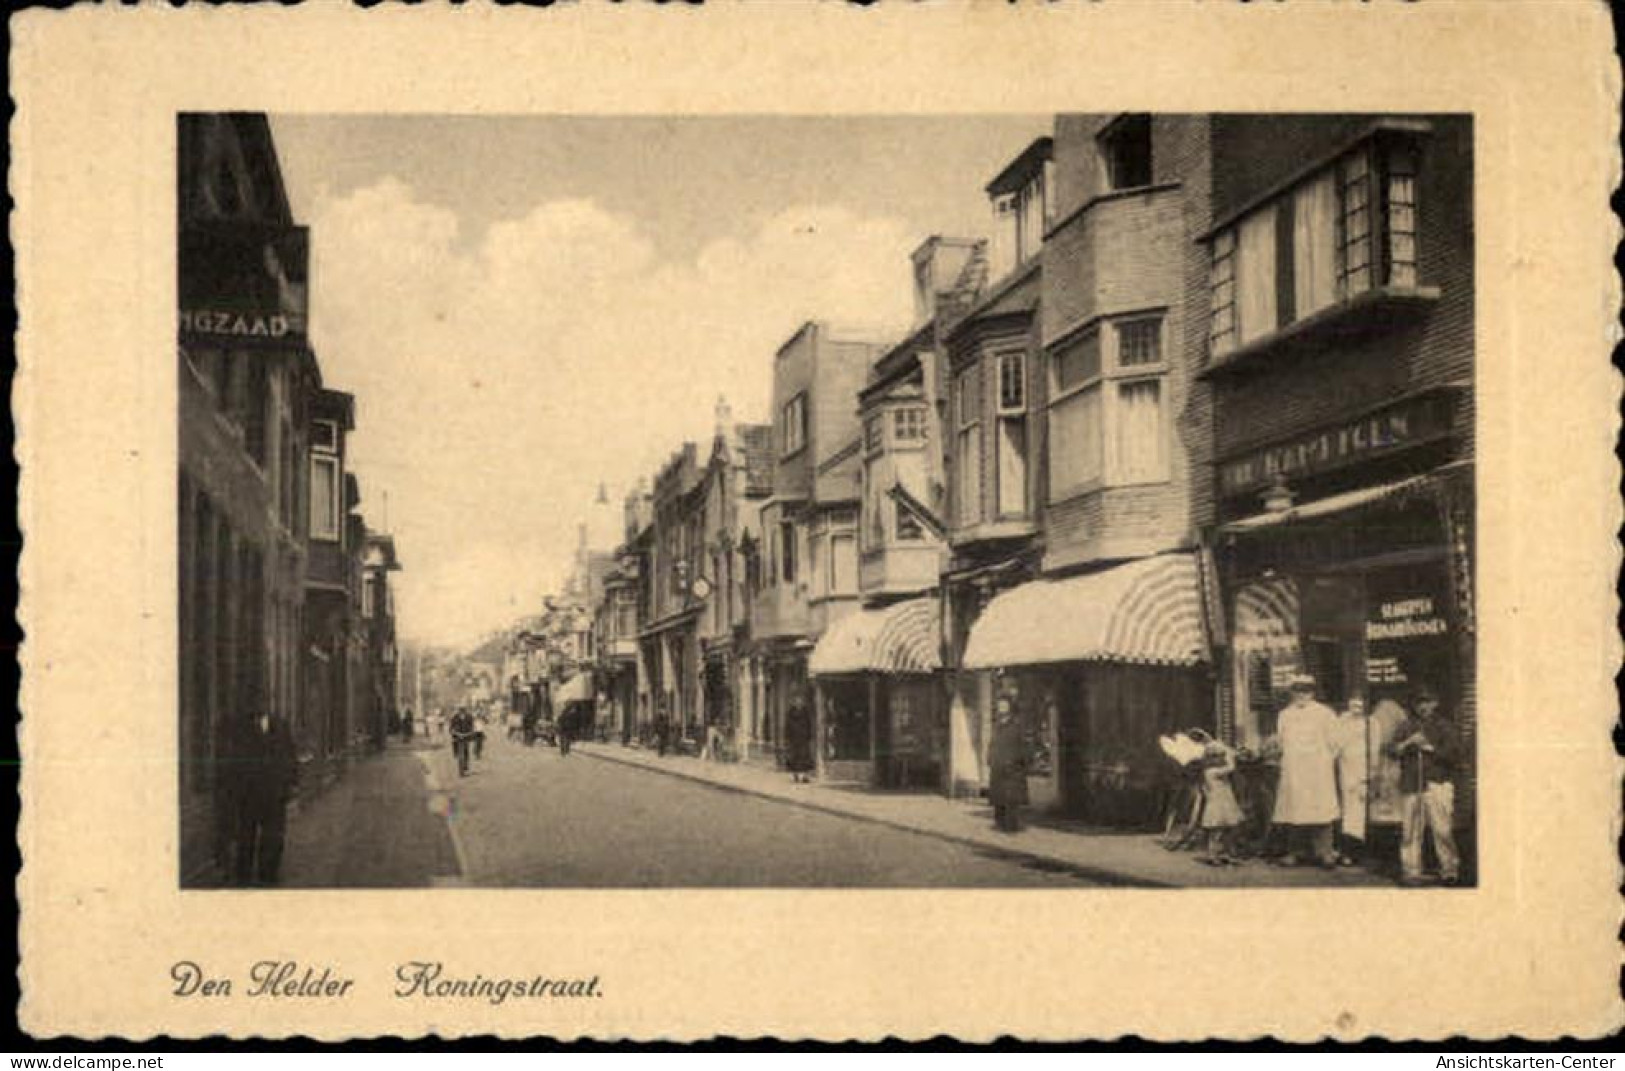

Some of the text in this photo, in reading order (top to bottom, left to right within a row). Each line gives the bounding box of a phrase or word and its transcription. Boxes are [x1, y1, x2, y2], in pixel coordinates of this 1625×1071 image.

[170, 960, 603, 1005] Den Helder Koningstraat.
